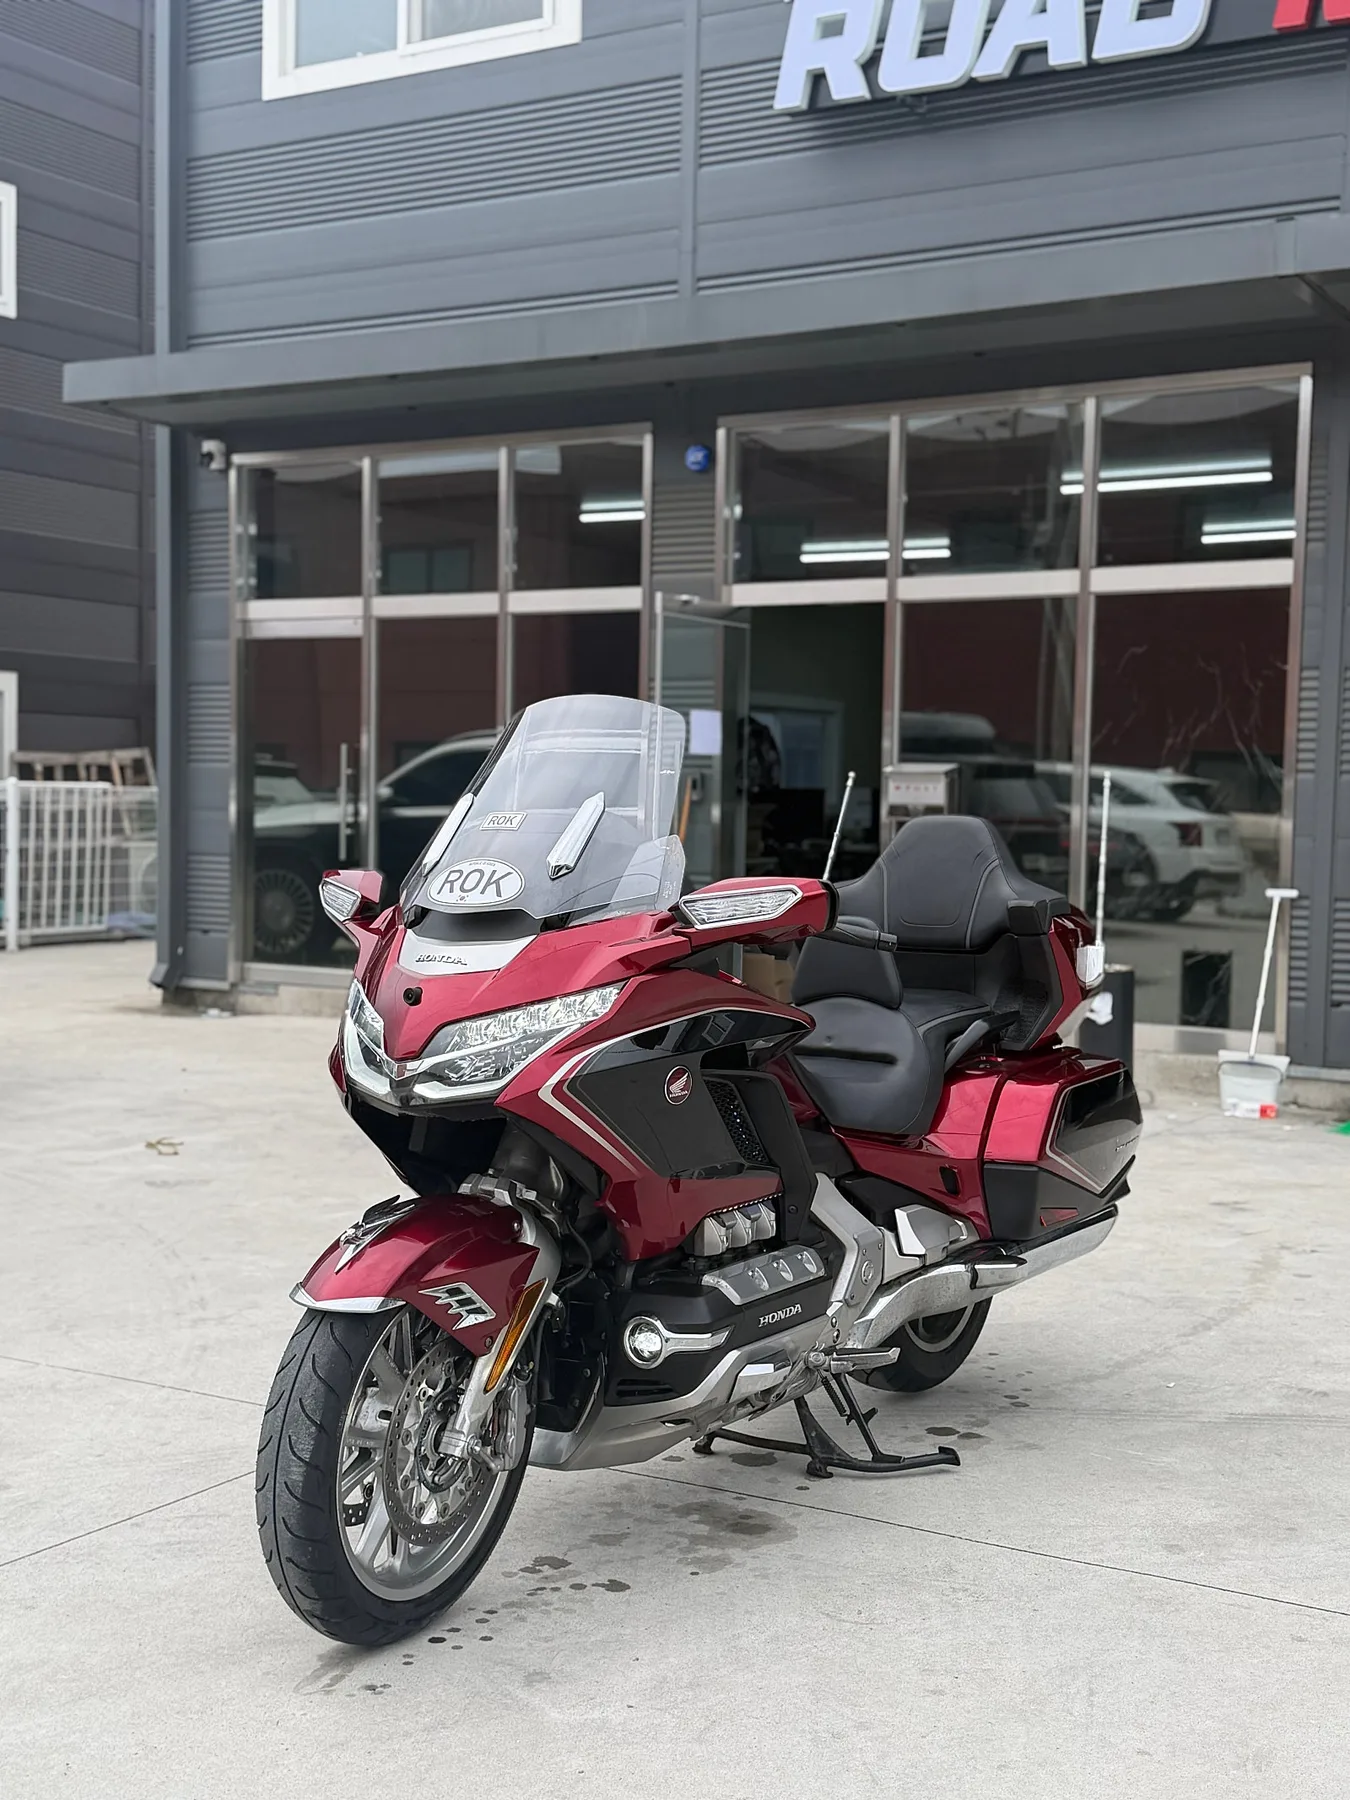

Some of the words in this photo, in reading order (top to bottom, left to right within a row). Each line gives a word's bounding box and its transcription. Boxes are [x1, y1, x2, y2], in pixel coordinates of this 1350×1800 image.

[487, 815, 518, 826] ROK
[436, 868, 514, 898] ROK
[414, 953, 468, 966] HONDA
[758, 1303, 802, 1328] HONDA
